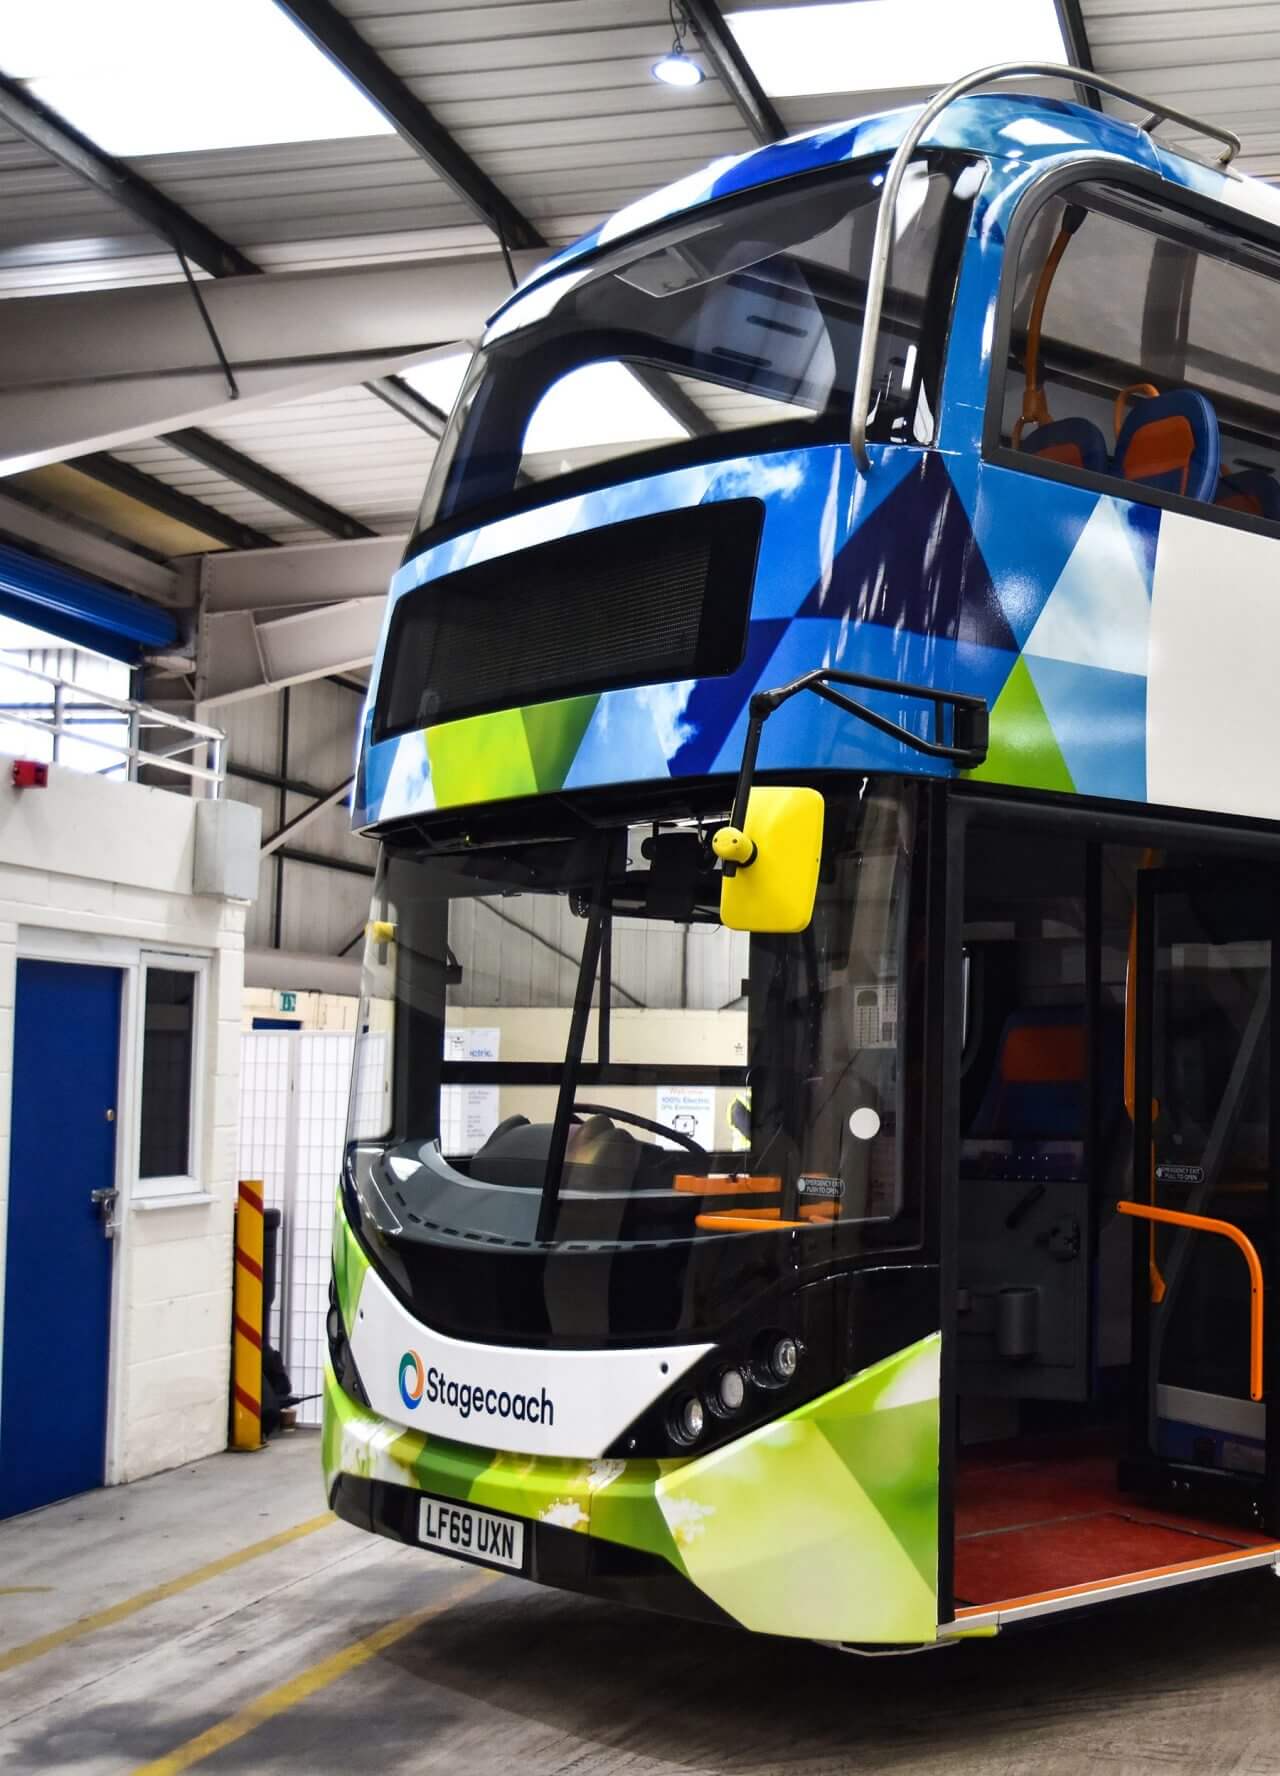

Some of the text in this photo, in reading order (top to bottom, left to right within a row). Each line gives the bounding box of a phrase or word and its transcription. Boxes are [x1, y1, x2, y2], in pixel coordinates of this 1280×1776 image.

[427, 1367, 554, 1426] Stagecoach
[426, 1503, 515, 1560] LF69 UXN
